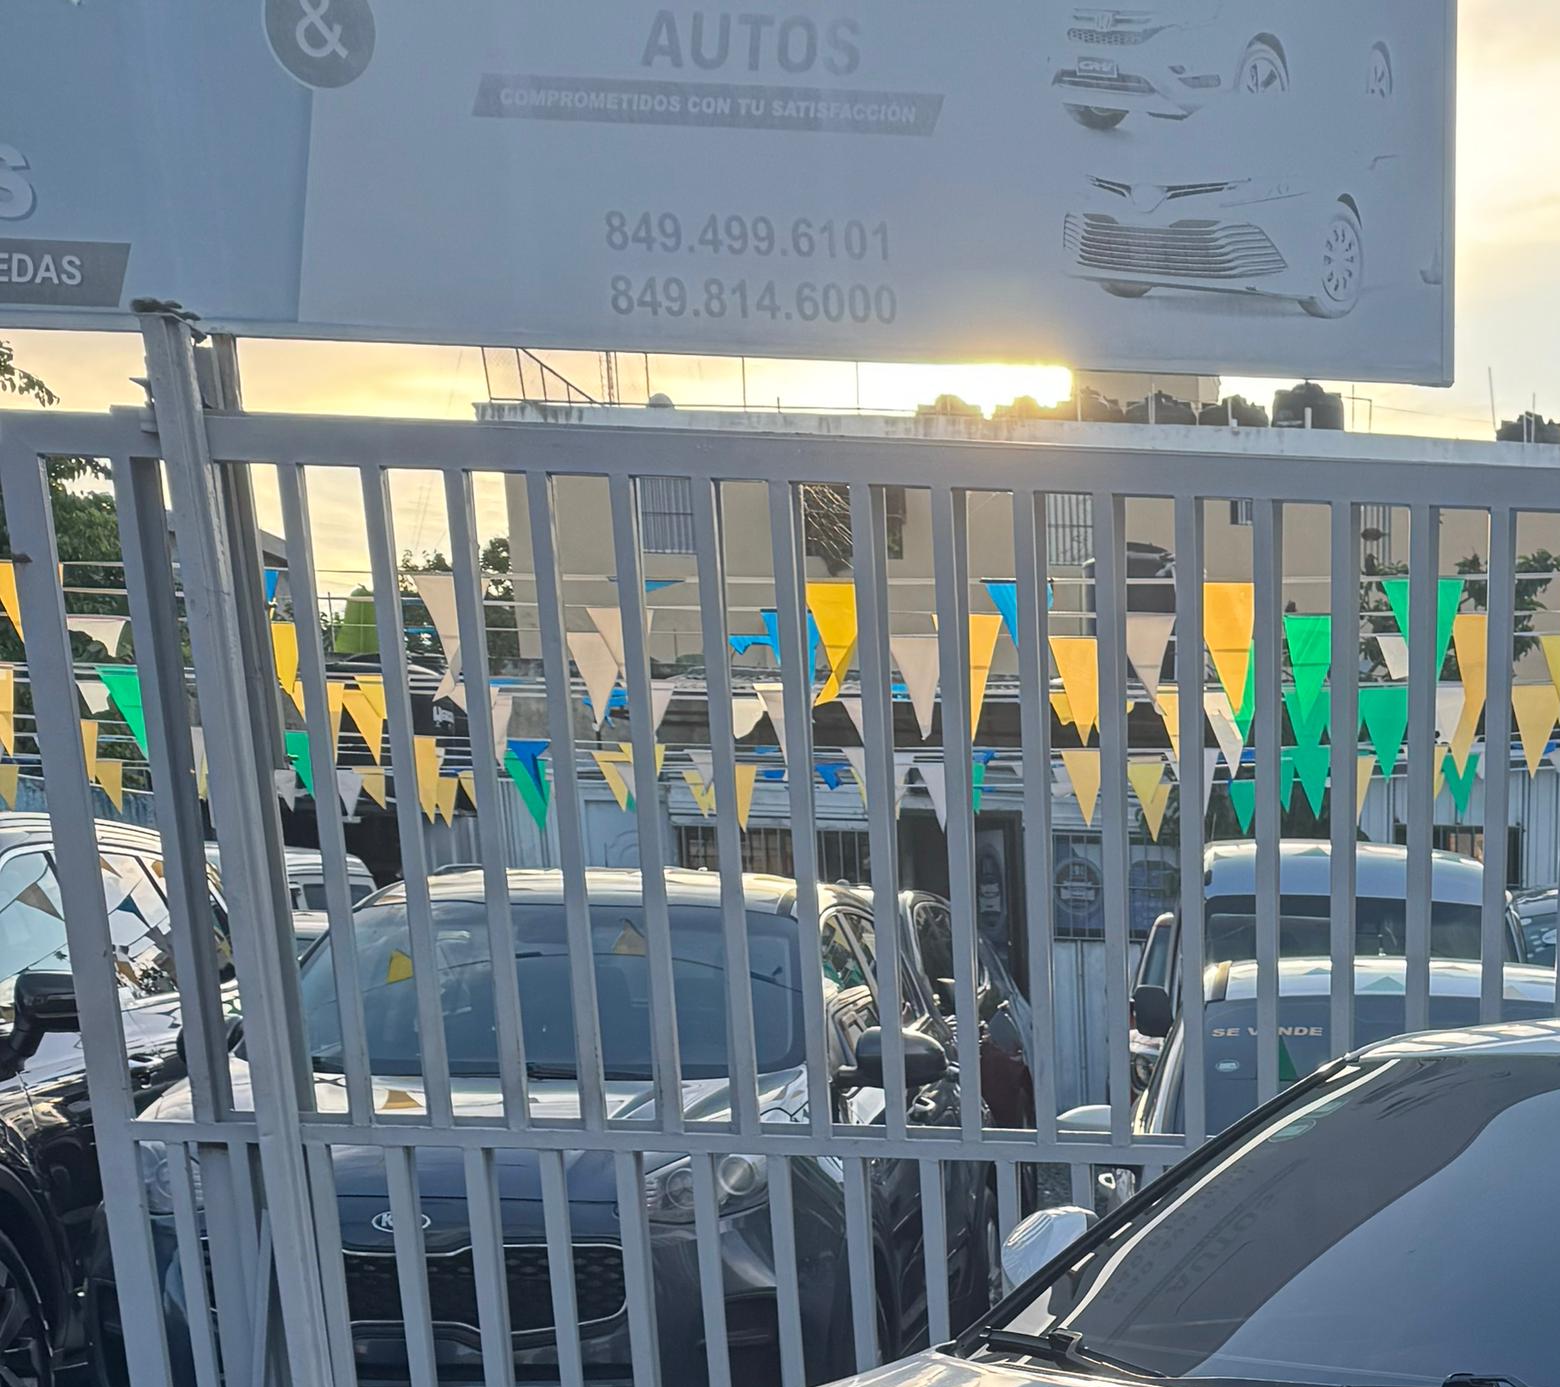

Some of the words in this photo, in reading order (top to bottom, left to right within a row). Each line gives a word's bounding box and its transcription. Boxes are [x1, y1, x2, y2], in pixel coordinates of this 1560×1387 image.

[296, 0, 349, 59] &
[641, 9, 861, 76] AUTOS
[501, 87, 681, 112] COMPROMETIDOS
[687, 96, 731, 115] CON
[737, 98, 766, 116] TU
[772, 100, 917, 123] SATISFACCIÓN
[605, 210, 889, 261] 849.499.6101
[610, 274, 897, 325] 849.814.6000
[1211, 1027, 1241, 1038] SE
[1247, 1026, 1324, 1037] VNDE
